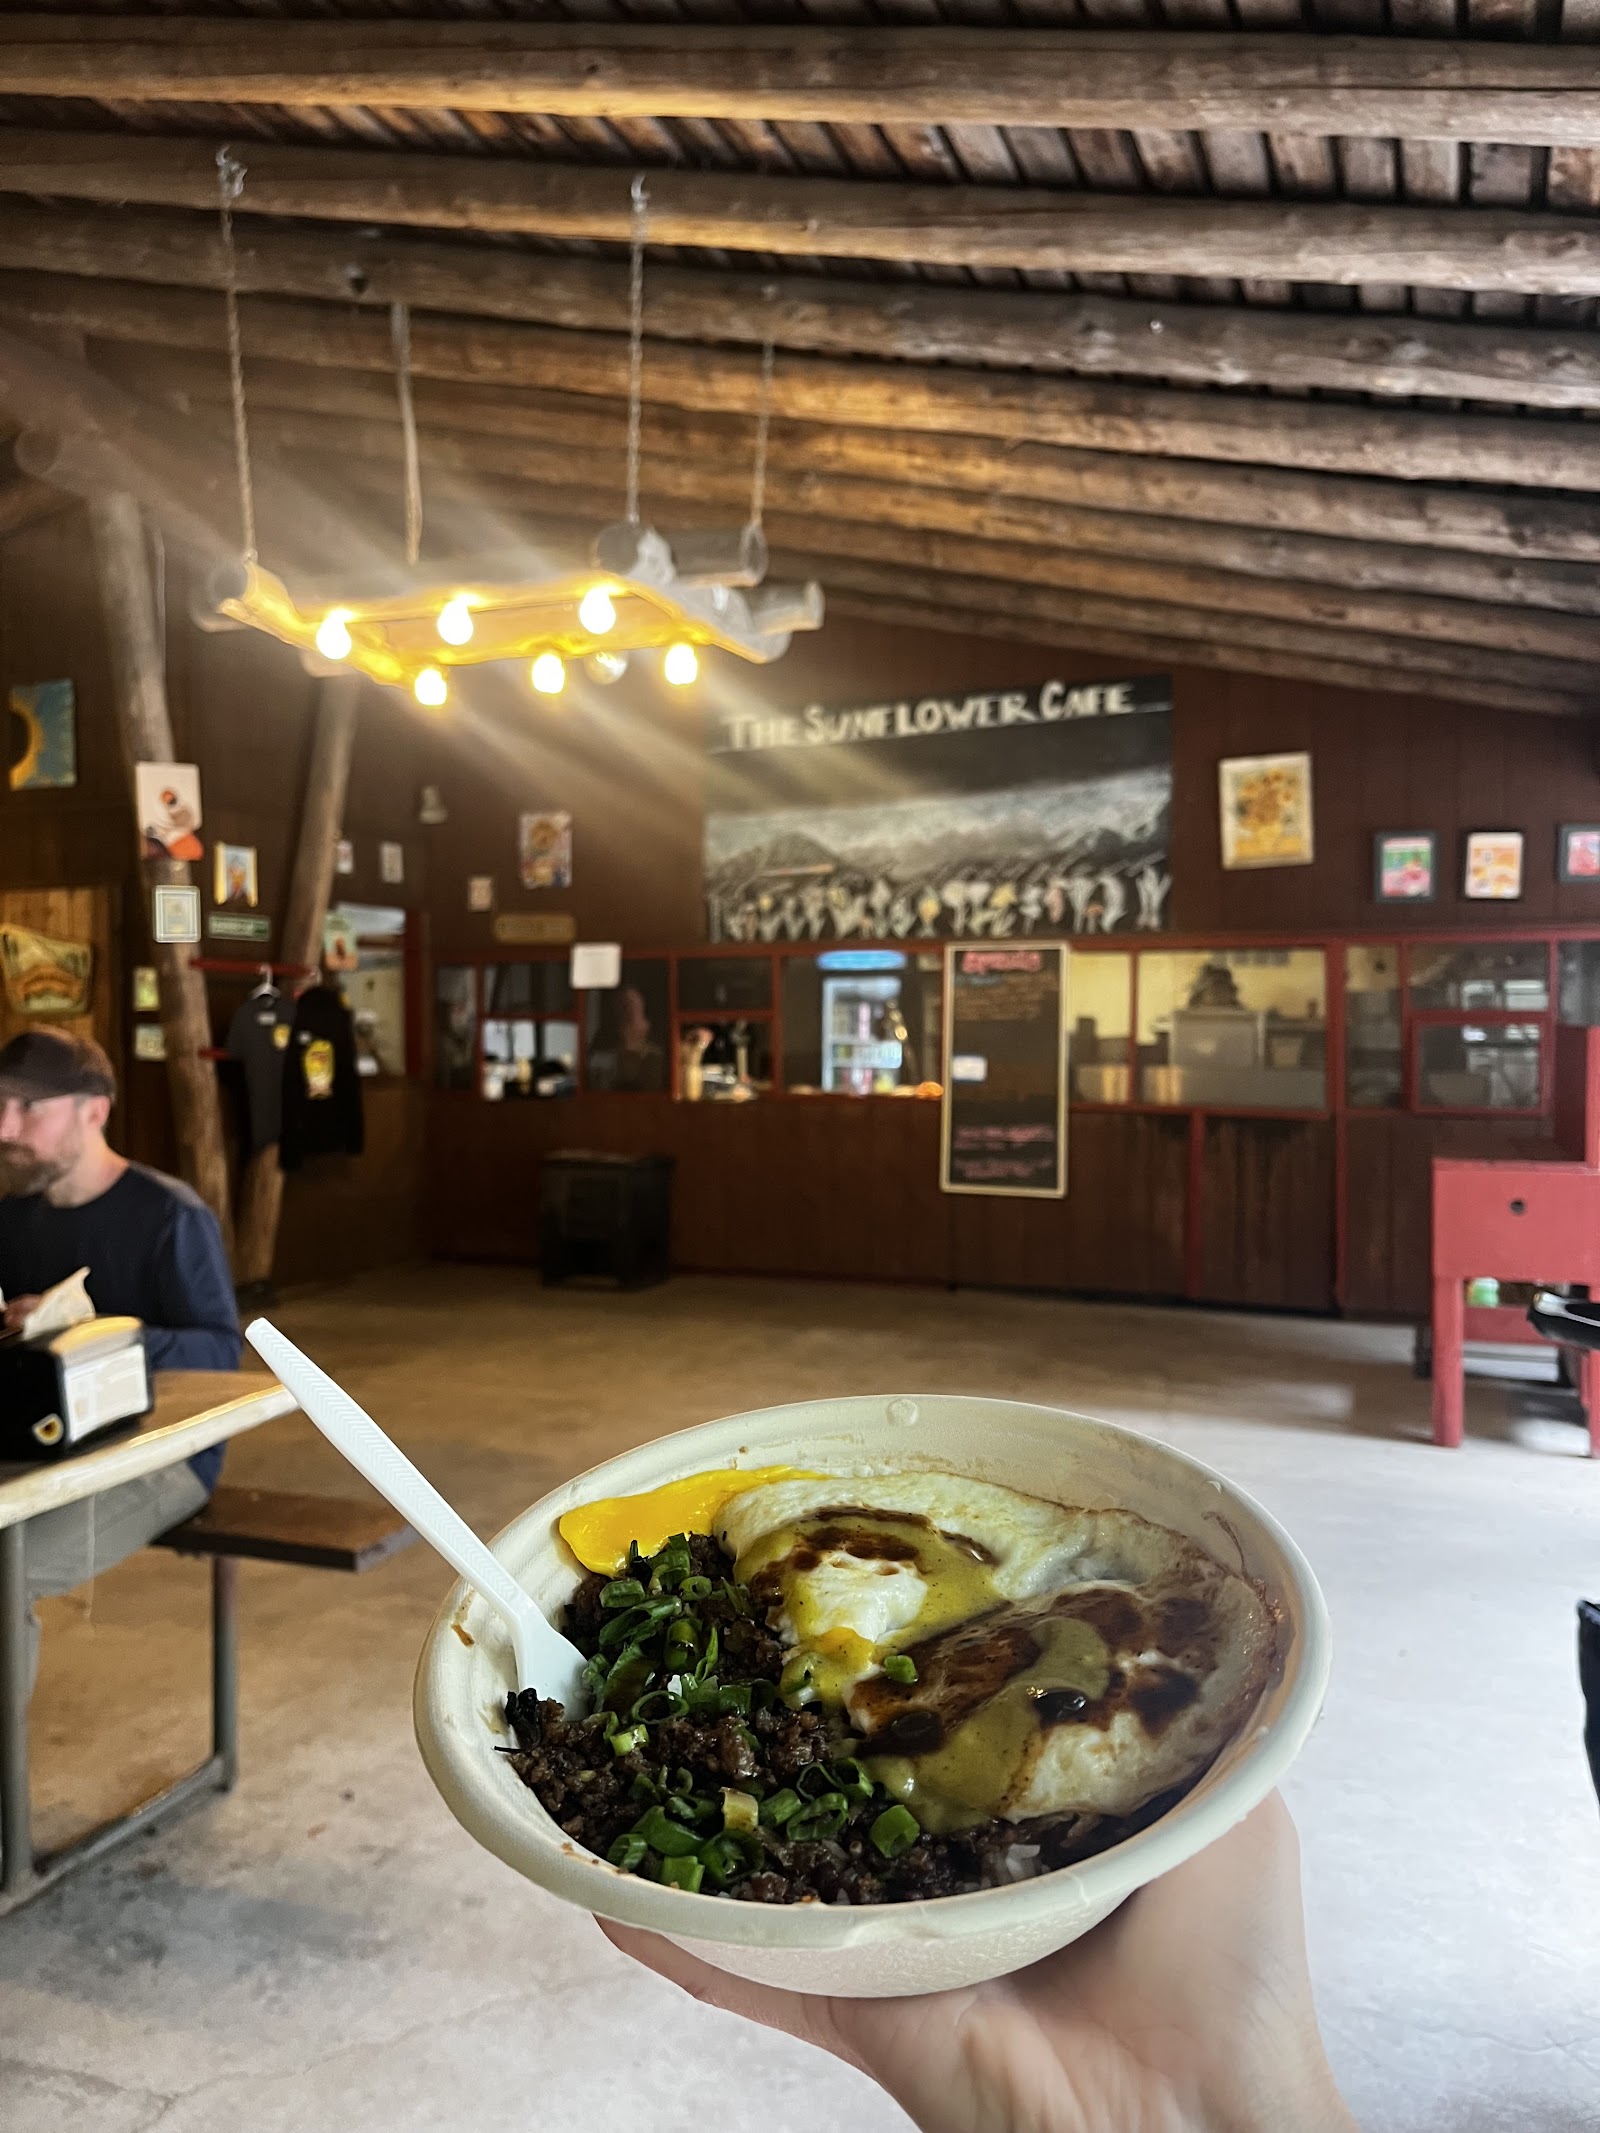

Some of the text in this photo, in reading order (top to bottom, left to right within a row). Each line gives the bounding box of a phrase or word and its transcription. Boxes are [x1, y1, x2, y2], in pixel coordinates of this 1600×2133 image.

[730, 680, 1135, 749] THE SUNFLOWER CAFE
